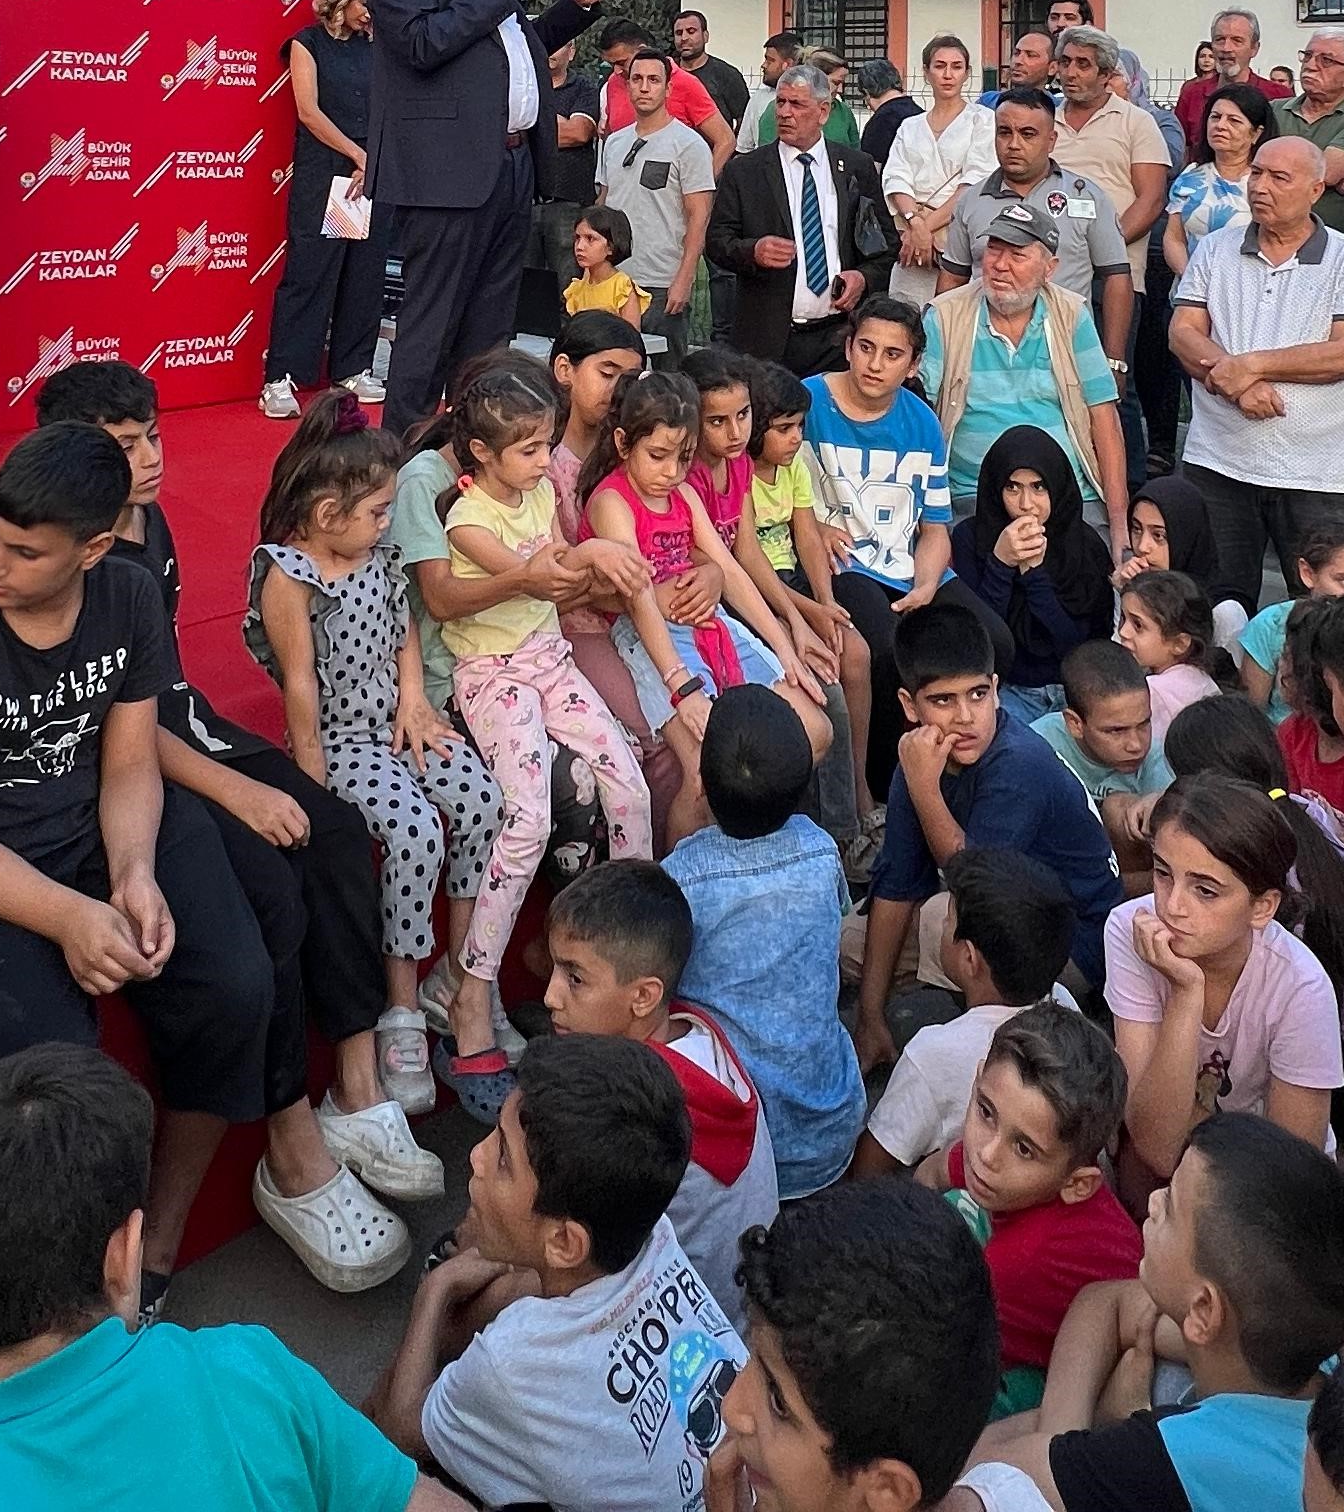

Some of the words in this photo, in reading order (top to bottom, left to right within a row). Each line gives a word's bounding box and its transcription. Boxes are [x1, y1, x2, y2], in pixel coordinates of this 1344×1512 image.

[51, 50, 118, 66] ZEYDAN
[218, 48, 256, 61] BÜYÜK
[50, 68, 128, 82] KARALAR
[222, 63, 256, 76] ŞEHİR
[217, 75, 256, 87] ADANA
[87, 141, 131, 153] BÜYÜK
[92, 155, 131, 170] ŞEHİR
[176, 151, 236, 164] ZEYDAN
[85, 169, 130, 181] ADANA
[176, 167, 244, 179] KARALAR
[209, 231, 248, 244] BÜYÜK
[39, 249, 106, 265] ZEYDAN
[213, 244, 247, 258] ŞEHİR
[207, 258, 248, 270] ADANA
[39, 264, 117, 281] KARALAR
[76, 336, 120, 351] BÜYÜK
[166, 336, 226, 354] ZEYDAN
[164, 350, 234, 369] KARALAR
[56, 647, 127, 694] SLEEP
[75, 678, 108, 702] DOG
[630, 1376, 668, 1456] ROAD
